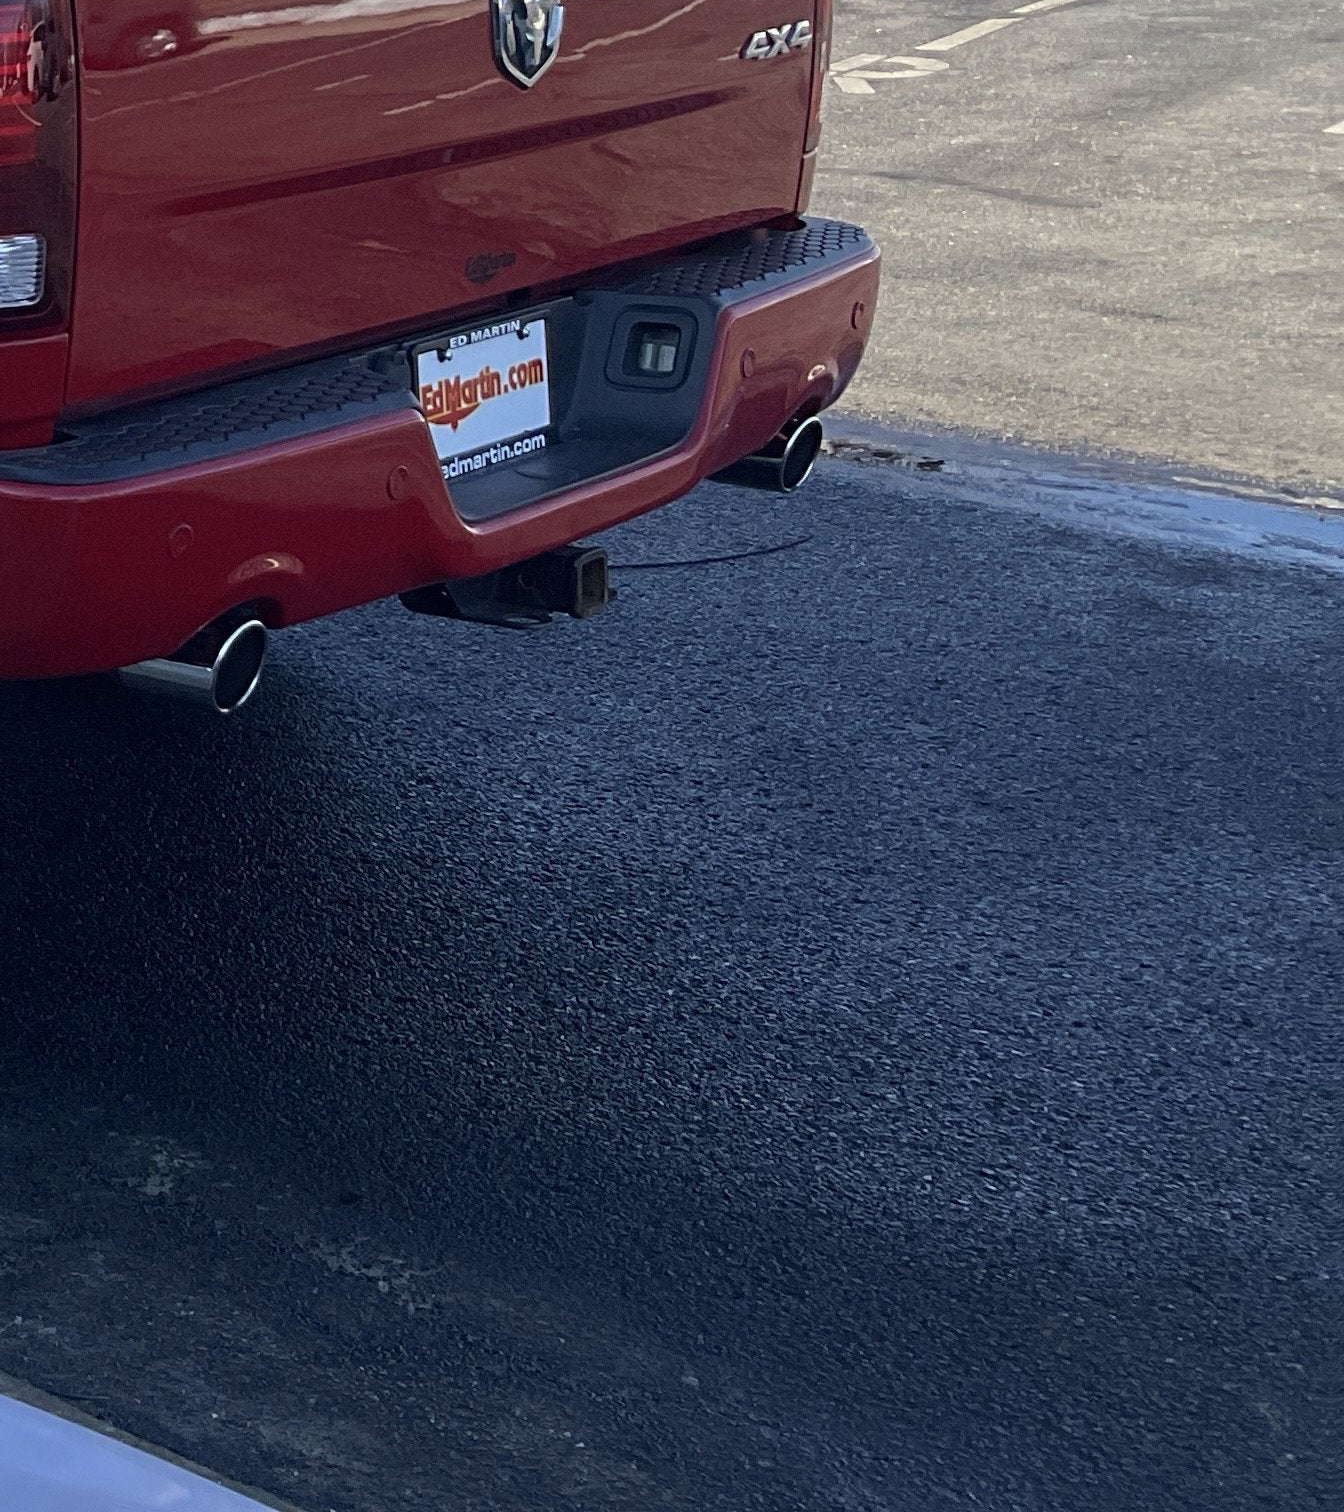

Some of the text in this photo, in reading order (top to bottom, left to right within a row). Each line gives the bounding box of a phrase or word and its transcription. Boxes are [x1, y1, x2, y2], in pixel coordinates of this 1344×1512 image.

[449, 319, 521, 349] ED MARTIN
[420, 357, 545, 413] EdMartin.com
[442, 433, 546, 480] edmartin.com
